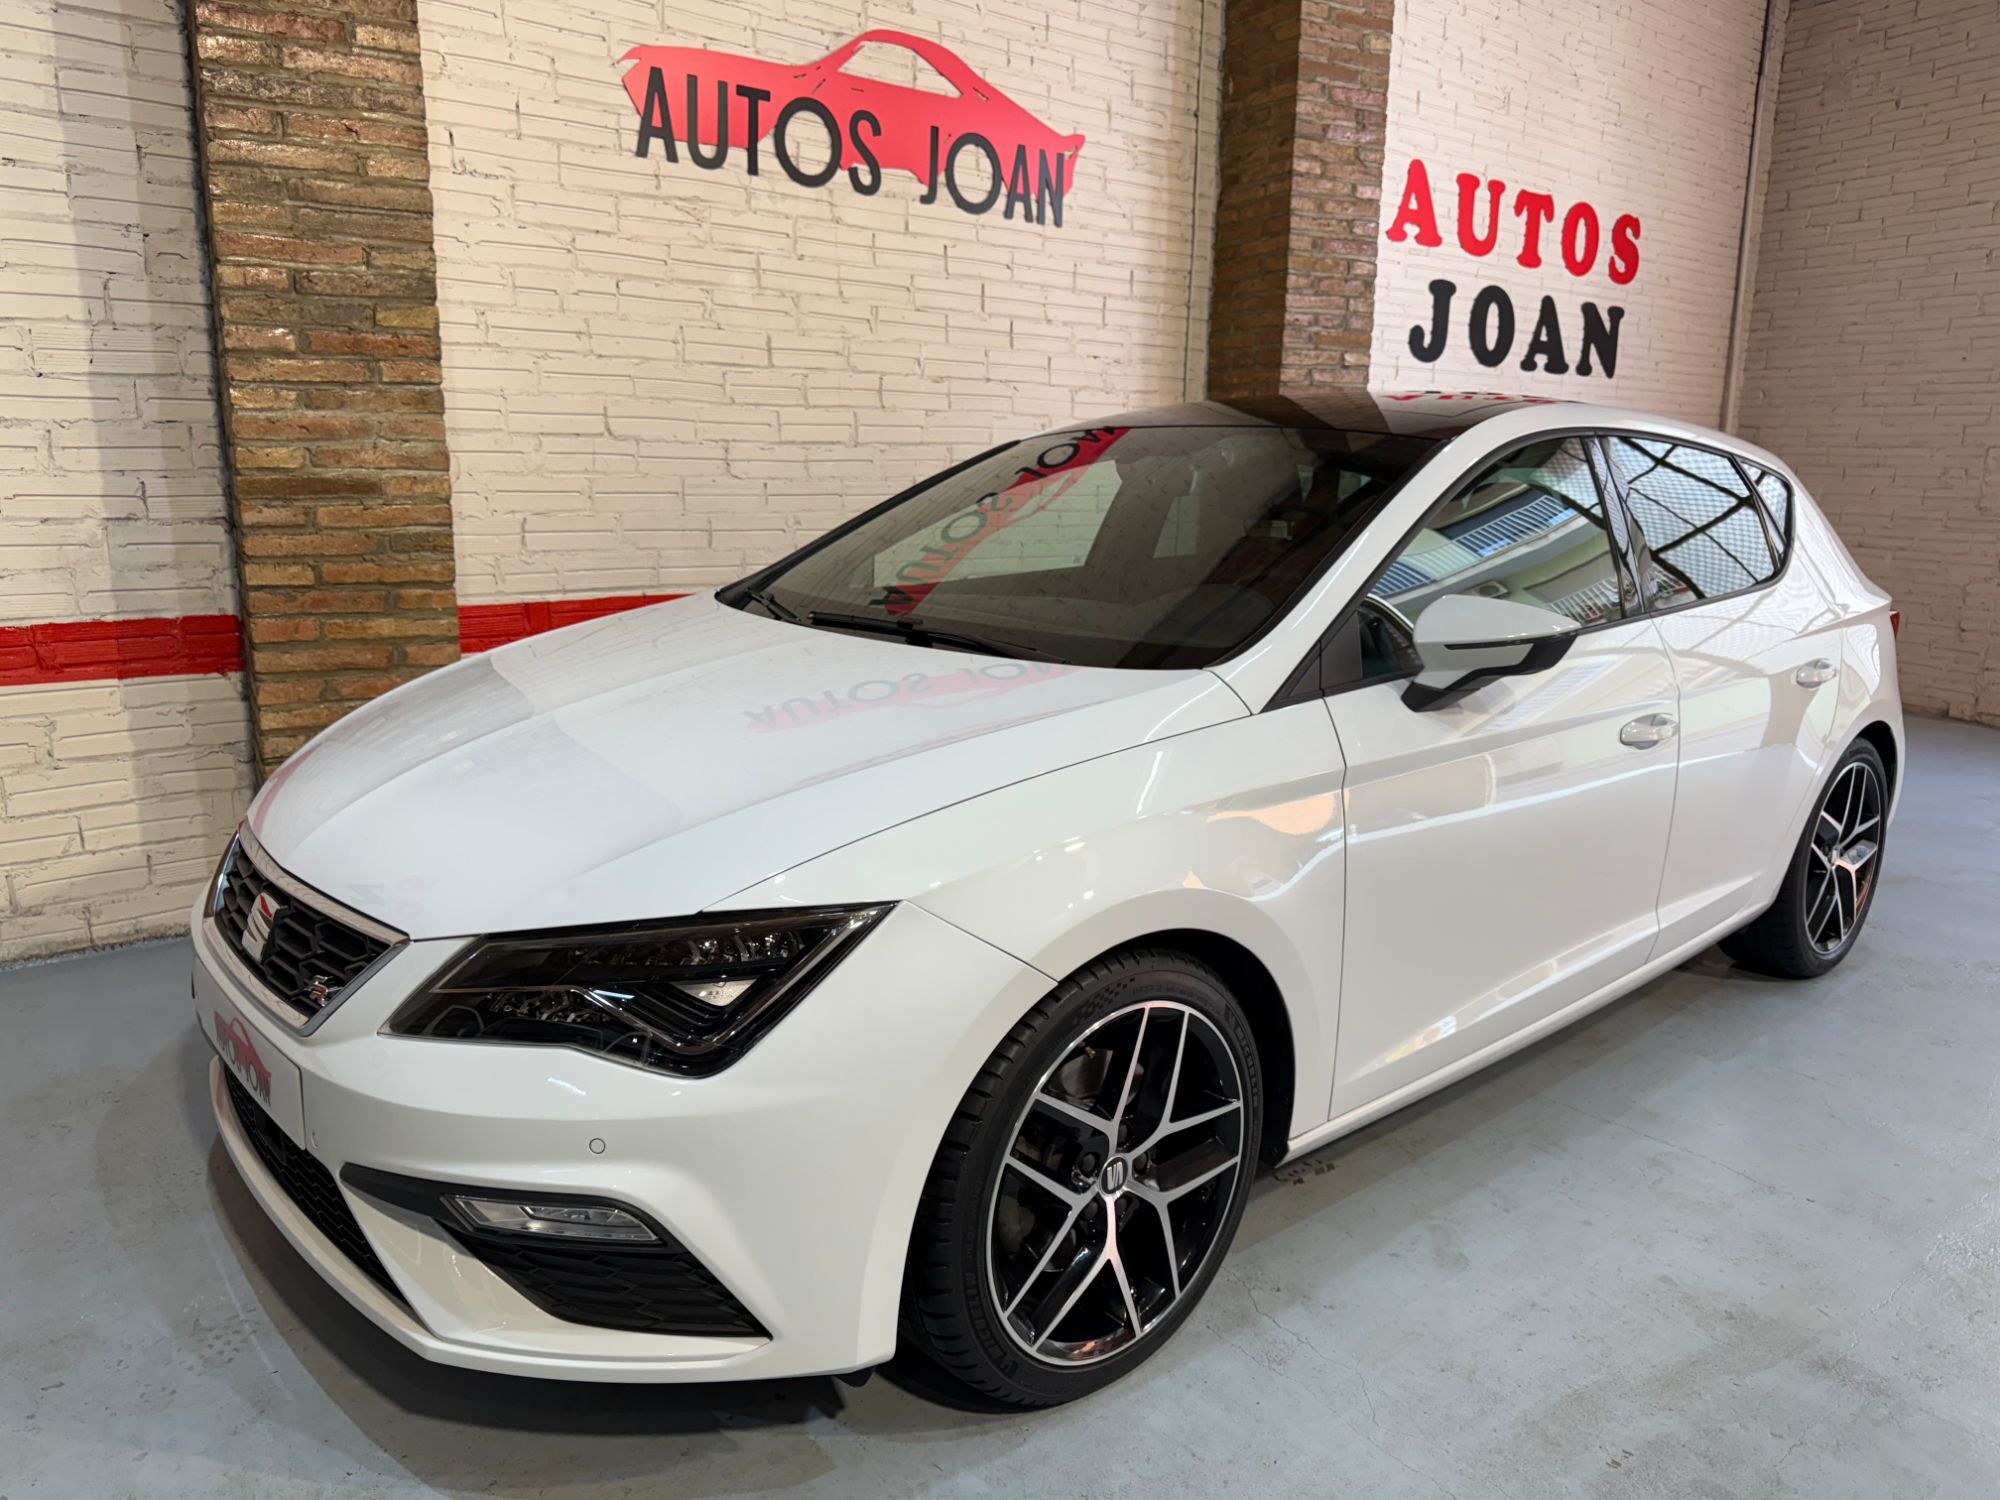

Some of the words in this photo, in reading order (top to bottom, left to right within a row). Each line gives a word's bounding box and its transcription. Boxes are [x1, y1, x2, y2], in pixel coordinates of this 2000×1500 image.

[636, 66, 882, 196] AUTOS
[921, 125, 1064, 228] JOAN
[1386, 159, 1641, 285] AUTOS
[1408, 279, 1625, 379] JOAN
